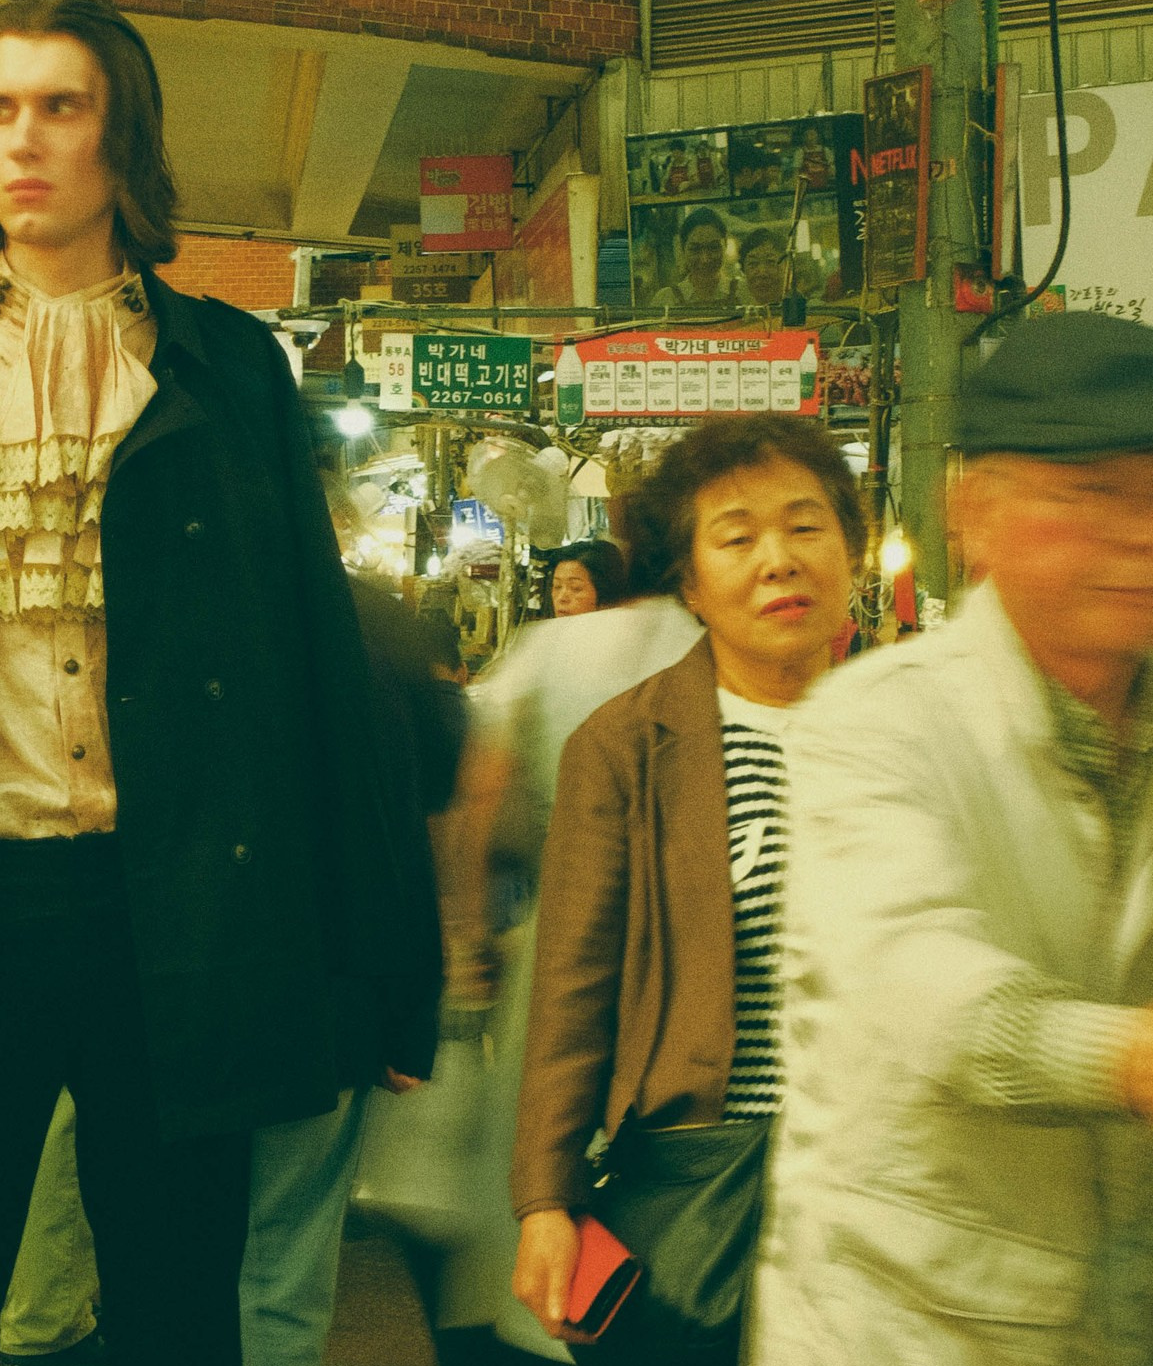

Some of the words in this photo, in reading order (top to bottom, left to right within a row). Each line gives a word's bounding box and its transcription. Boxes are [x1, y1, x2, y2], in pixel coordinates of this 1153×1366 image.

[870, 144, 918, 178] NETFLIX
[412, 282, 448, 298] 35호
[428, 343, 486, 360] 박가네
[665, 340, 709, 354] 박가네
[717, 340, 760, 354] 빈대떡
[388, 362, 405, 376] 58
[391, 383, 403, 395] 호
[431, 391, 522, 405] 2267-0614
